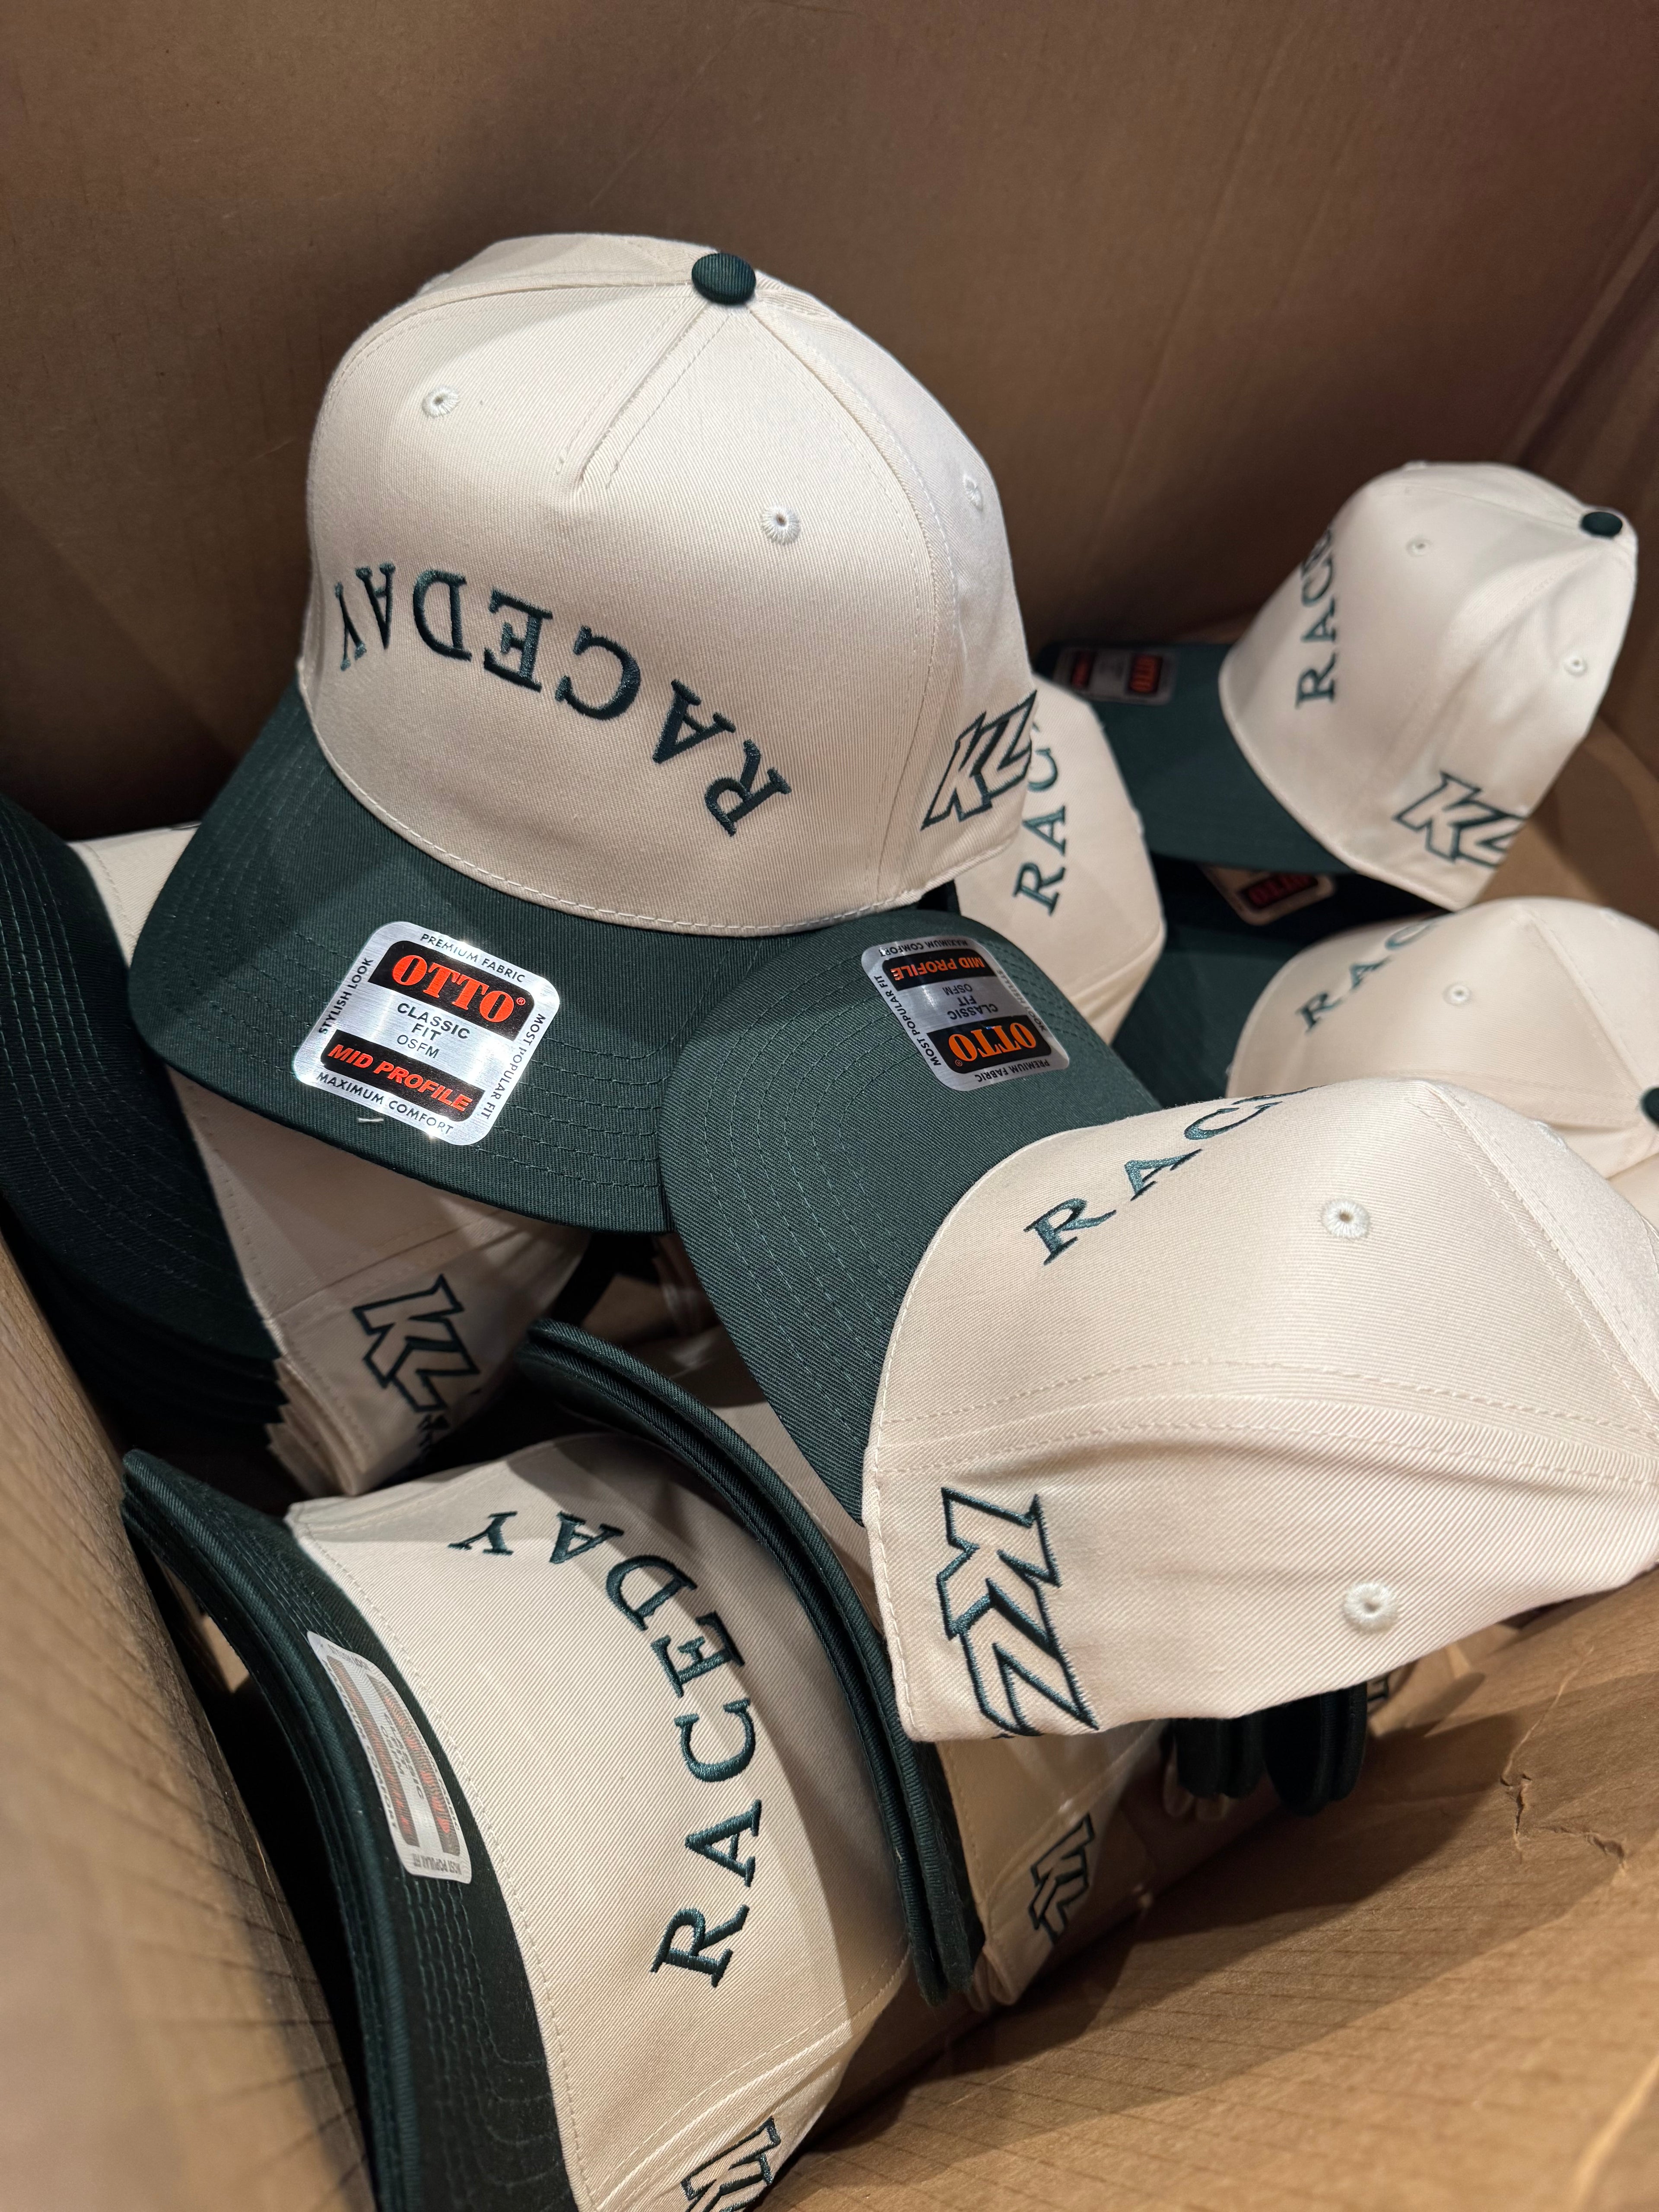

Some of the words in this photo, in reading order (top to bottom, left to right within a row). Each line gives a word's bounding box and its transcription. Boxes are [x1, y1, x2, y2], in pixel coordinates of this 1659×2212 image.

[335, 561, 791, 836] RACEDAY
[879, 942, 924, 957] COMFORT
[925, 939, 968, 949] MAXIMUM
[420, 934, 478, 963] PREMIUM
[481, 958, 526, 983] FABRIC
[890, 958, 958, 981] PROFILE
[958, 957, 985, 969] MID
[874, 975, 888, 988] FIT
[942, 983, 973, 996] OSFM
[319, 991, 352, 1034] STYLISH
[347, 957, 374, 989] LOOK
[957, 995, 977, 1007] FIT
[397, 1003, 470, 1039] CLASSIC
[885, 990, 921, 1036] POPULAR
[947, 1003, 998, 1020] CLASSIC
[412, 1022, 441, 1041] FIT
[523, 1013, 546, 1046] MOST
[397, 1035, 439, 1059] OSFM
[916, 1037, 941, 1066] MOST
[491, 1047, 527, 1100] POPULAR
[974, 1068, 1009, 1083] FABRIC
[1009, 1058, 1050, 1073] PREMIUM
[327, 1044, 373, 1068] MID
[373, 1061, 473, 1112] PROFILE
[316, 1071, 384, 1105] MAXIMUM
[389, 1100, 454, 1135] COMFORT
[481, 1102, 496, 1120] FIT
[448, 1510, 763, 1987] RACEDAY
